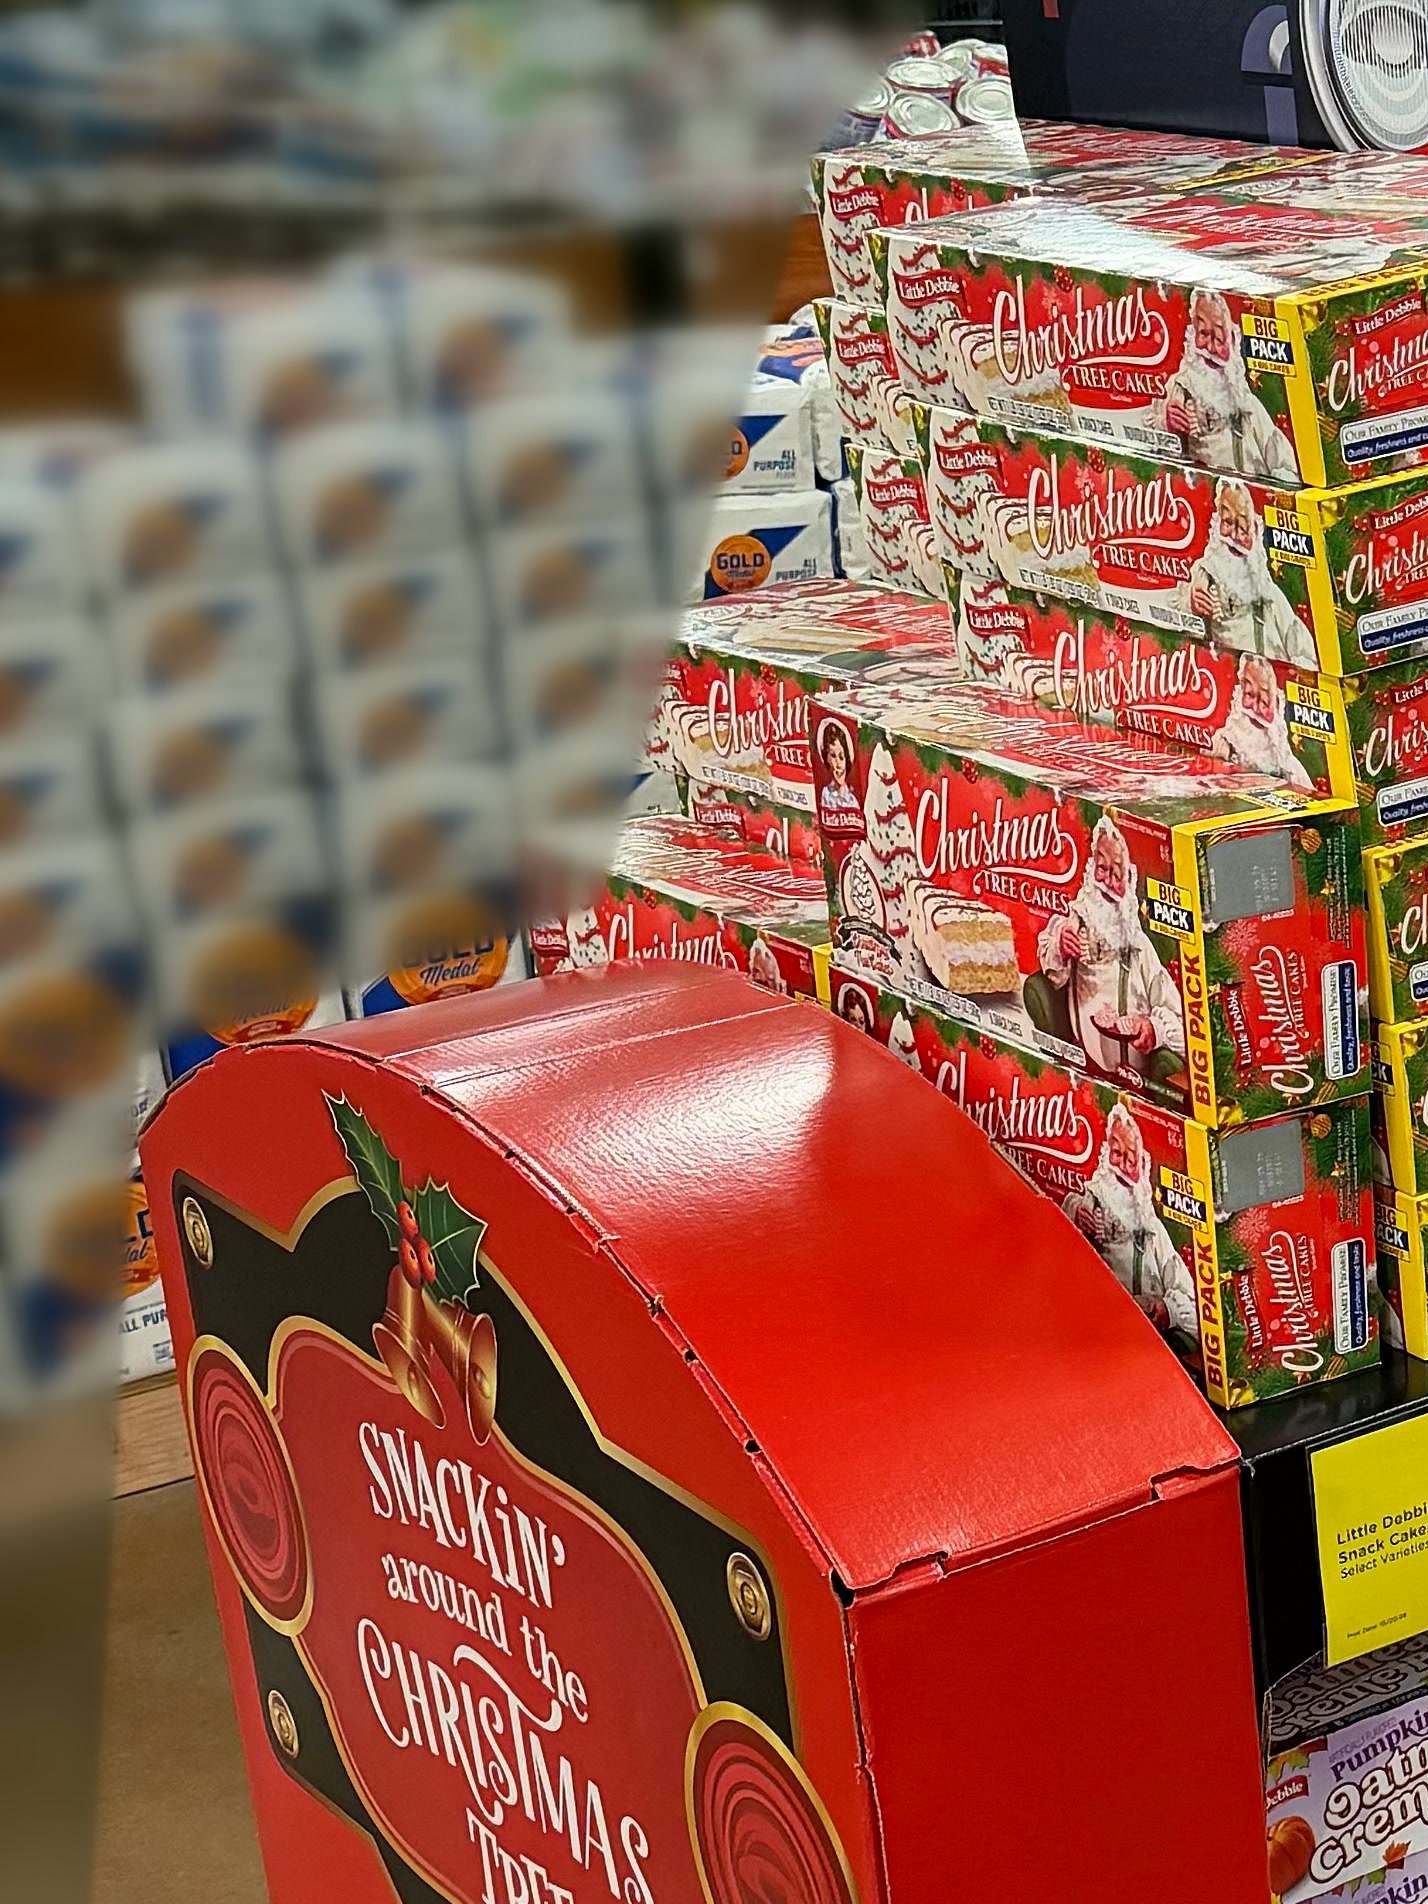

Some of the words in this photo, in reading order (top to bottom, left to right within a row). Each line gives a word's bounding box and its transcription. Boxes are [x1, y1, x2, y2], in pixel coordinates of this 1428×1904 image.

[898, 276, 929, 299] Little
[930, 276, 960, 297] Debbie
[992, 274, 1171, 386] Christmas
[1253, 314, 1279, 338] BIG
[1355, 316, 1384, 335] Little
[1385, 299, 1422, 324] Debbie
[1249, 338, 1288, 363] PACK
[1061, 365, 1108, 393] TREE
[1109, 371, 1167, 398] CAKES
[1378, 376, 1415, 396] TREE
[754, 461, 795, 471] PURPOSE
[782, 449, 795, 459] ALL
[716, 553, 764, 570] GOLD
[915, 777, 1078, 894] Christmas
[973, 867, 1018, 900] TREE
[1019, 877, 1071, 916] CAKES
[1158, 881, 1181, 906] BIG
[1152, 902, 1193, 935] PACK
[1185, 954, 1206, 1041] PACK
[1191, 1046, 1211, 1107] BIG
[1336, 1517, 1381, 1547] Little
[1338, 1538, 1386, 1566] Snack
[1340, 1555, 1379, 1581] Select
[381, 1551, 510, 1658] around
[521, 1610, 590, 1723] the
